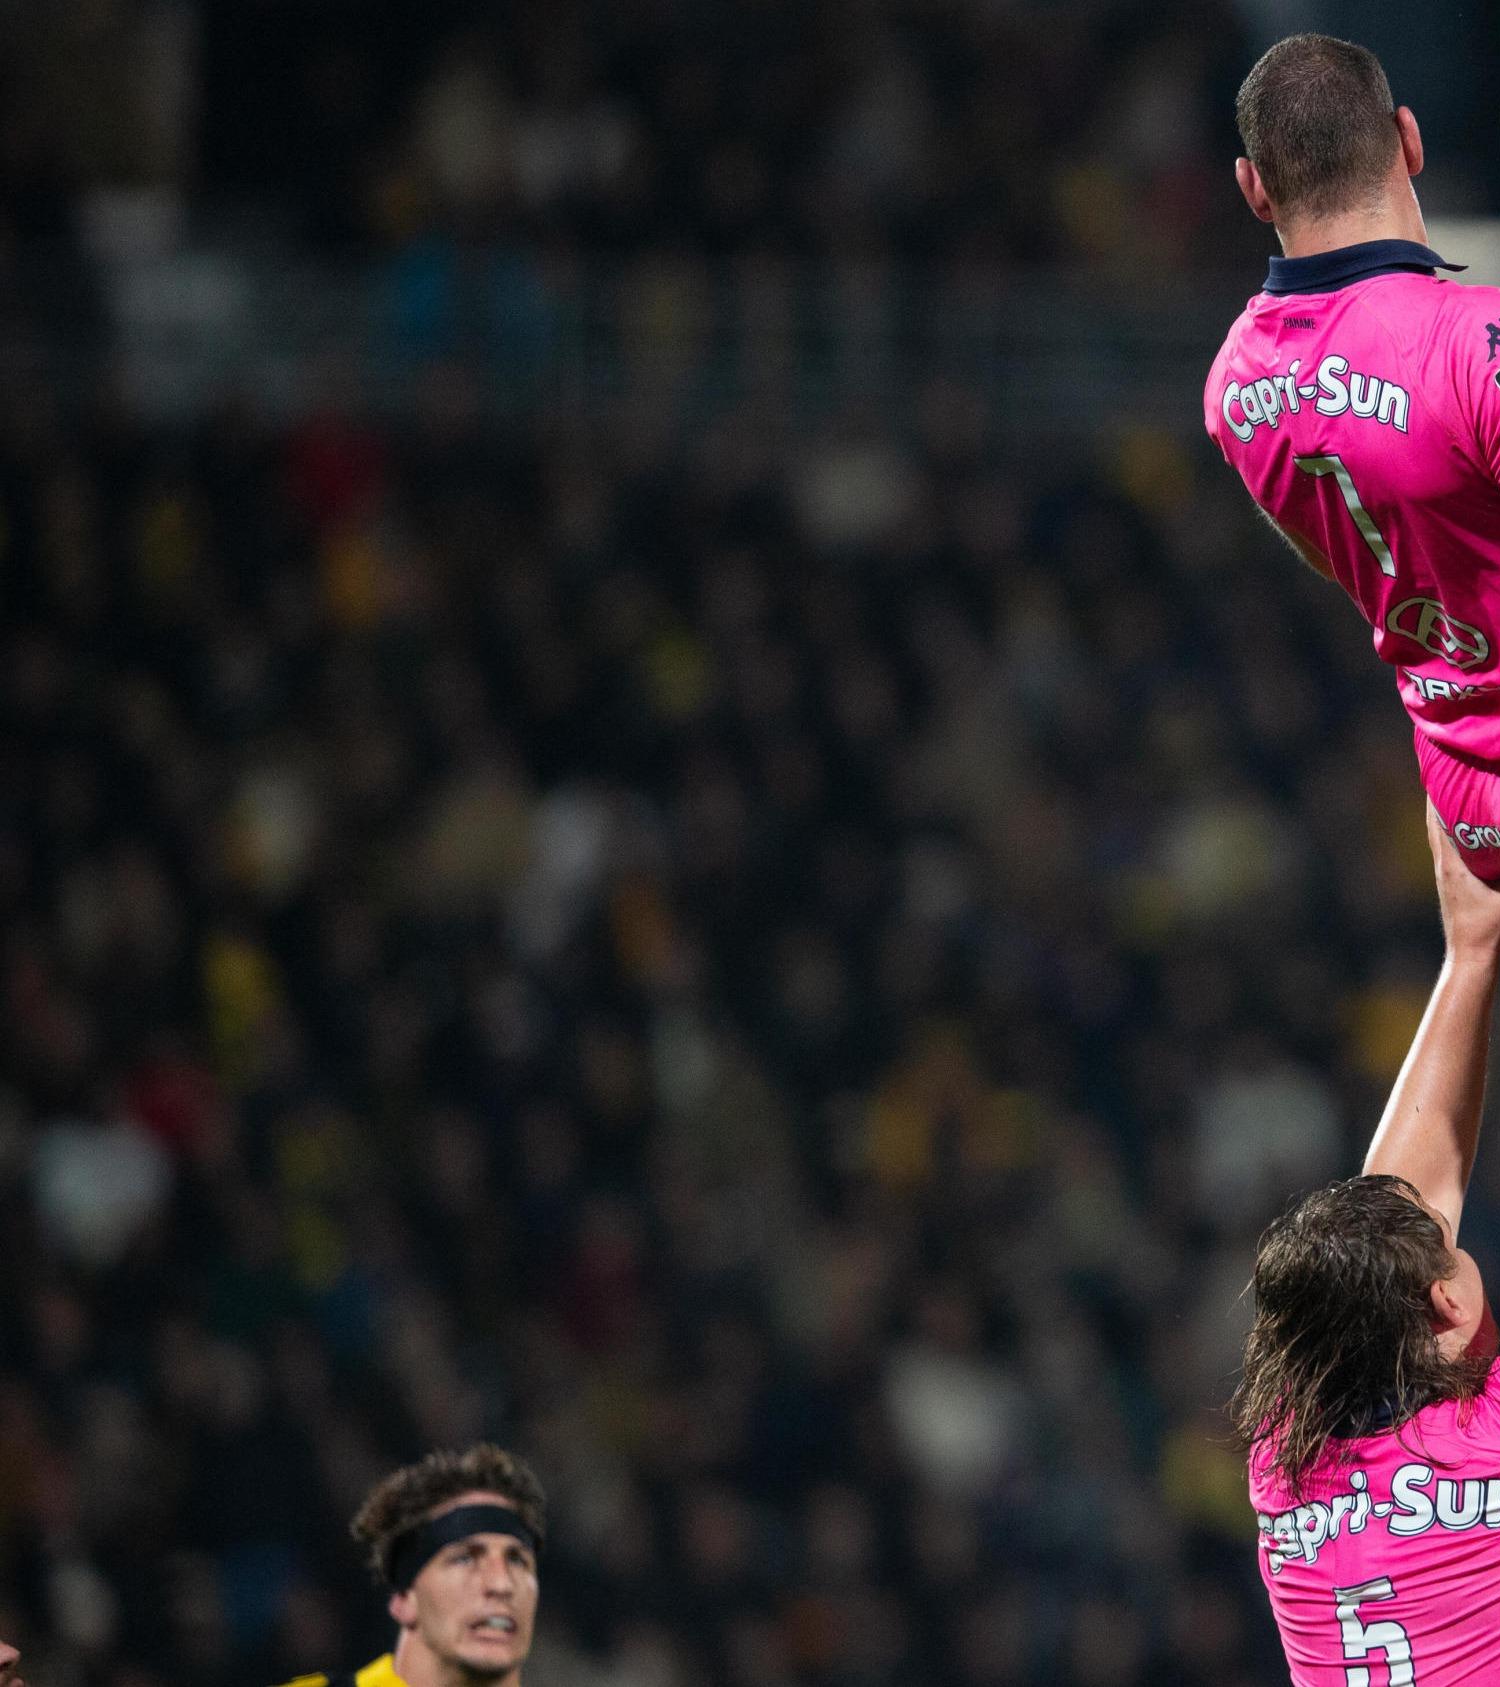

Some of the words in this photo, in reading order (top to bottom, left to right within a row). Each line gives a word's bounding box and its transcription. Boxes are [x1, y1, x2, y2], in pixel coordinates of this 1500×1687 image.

[1283, 317, 1316, 330] PANAME
[1222, 354, 1410, 443] Capri-Sun
[1293, 454, 1398, 579] 7
[1333, 1576, 1416, 1687] 5
